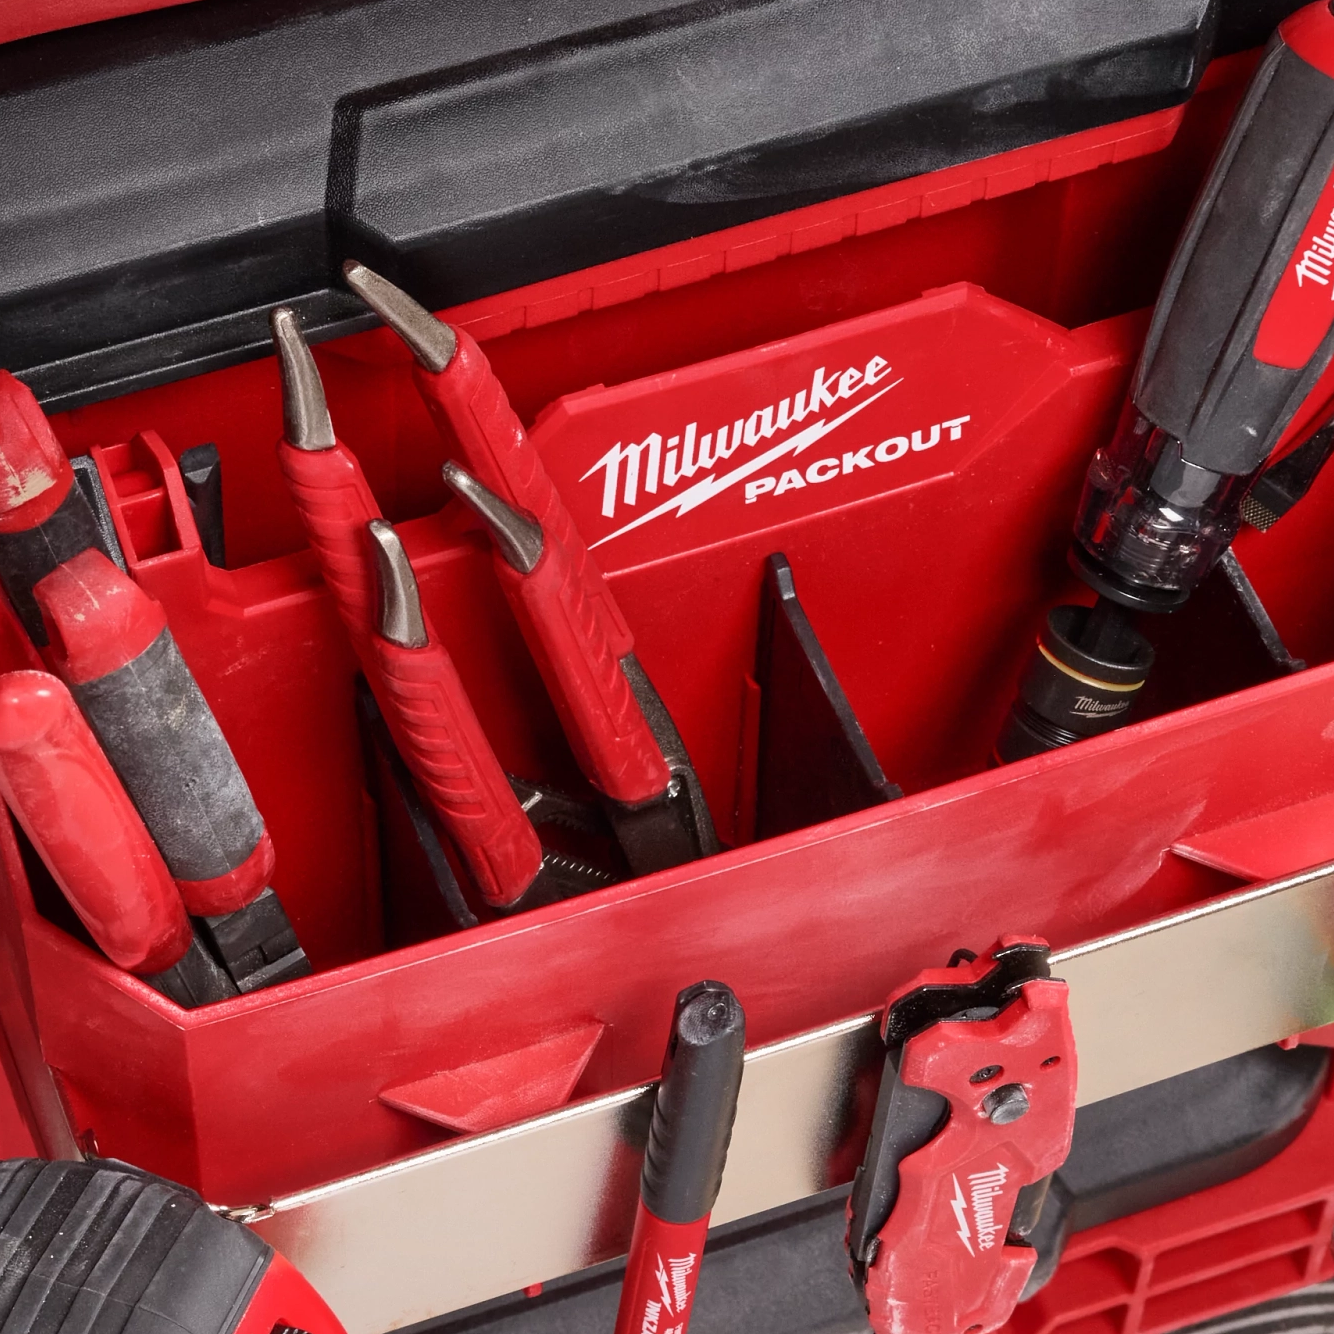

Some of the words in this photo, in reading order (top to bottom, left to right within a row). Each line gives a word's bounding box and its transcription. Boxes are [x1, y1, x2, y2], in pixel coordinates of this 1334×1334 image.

[578, 354, 893, 519] Milwaukee
[744, 415, 971, 505] PACKOUT
[1074, 696, 1130, 712] Milwaukee
[967, 1162, 1010, 1252] Milwaukee
[667, 1252, 697, 1313] Milwaukee
